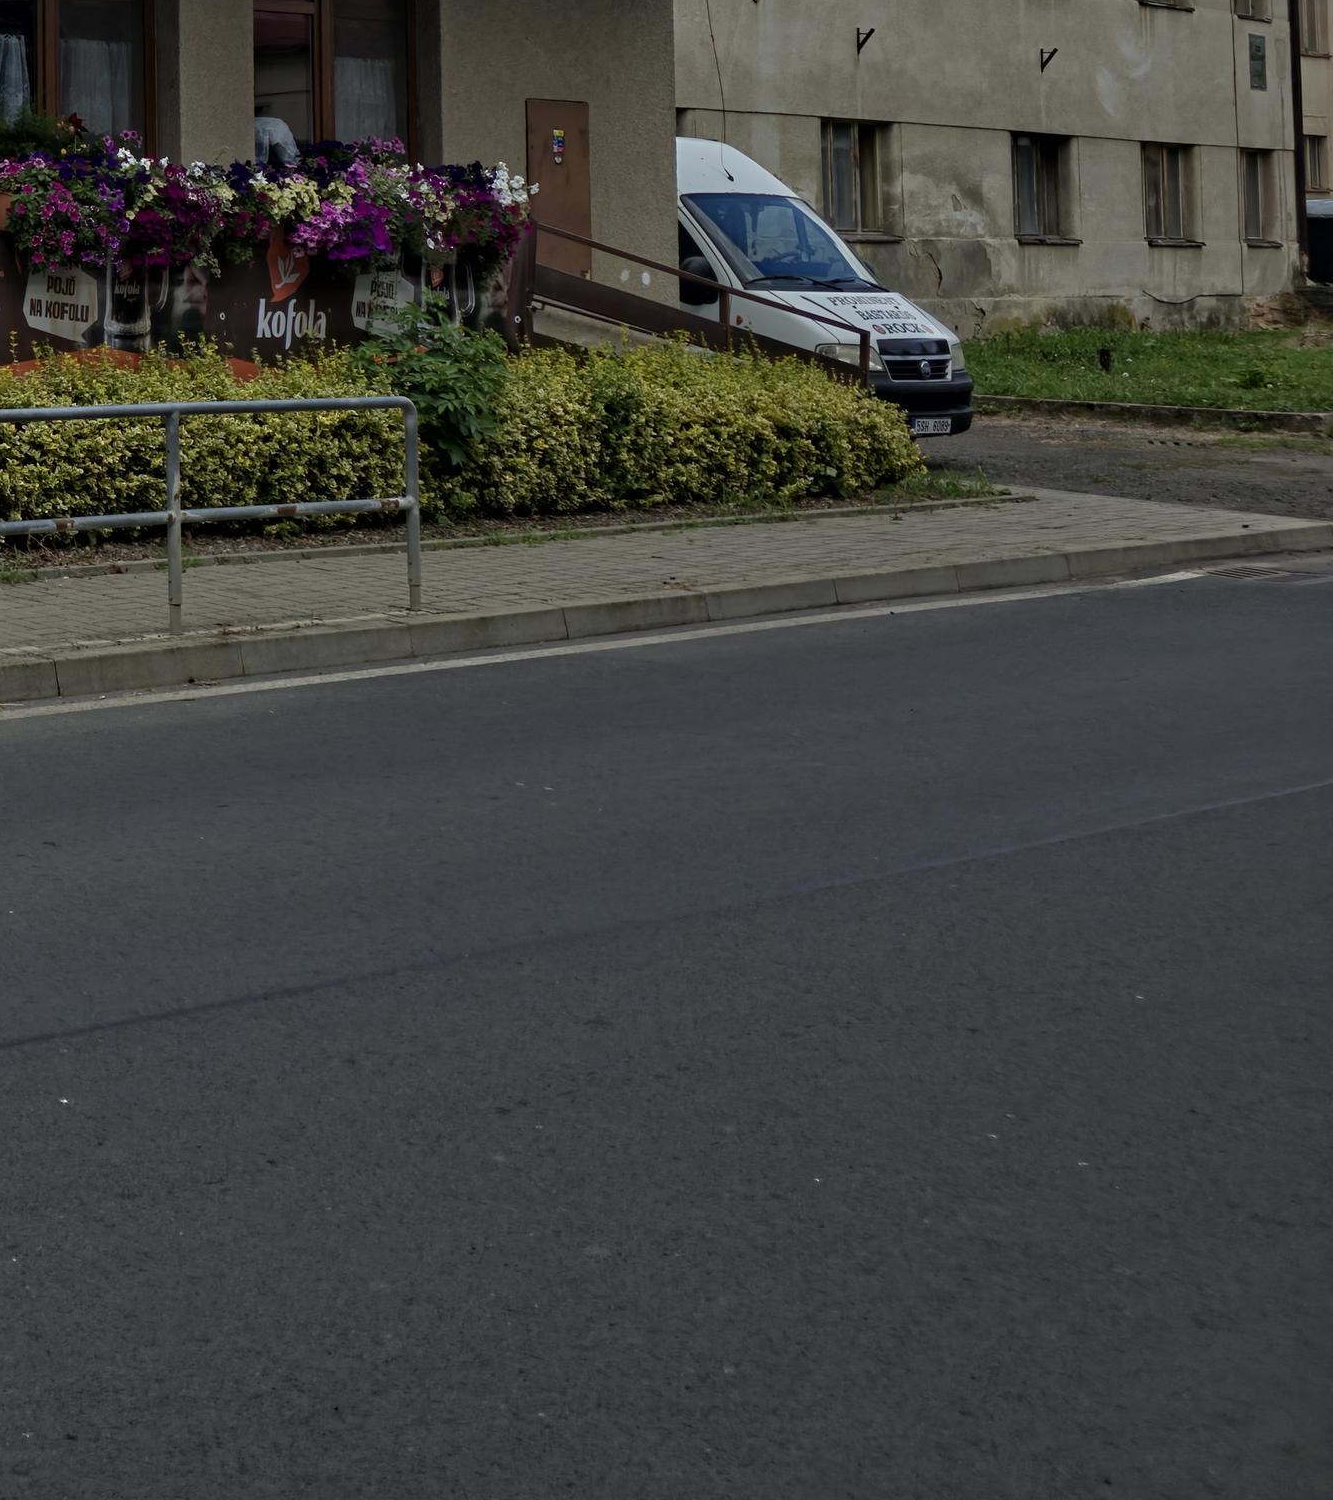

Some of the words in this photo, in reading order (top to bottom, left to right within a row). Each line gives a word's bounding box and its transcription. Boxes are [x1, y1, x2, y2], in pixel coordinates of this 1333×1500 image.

[47, 275, 76, 296] POJĎ
[29, 298, 42, 316] NA
[45, 300, 89, 322] KOFOLU
[256, 298, 327, 350] kofola
[880, 323, 925, 334] ROCK
